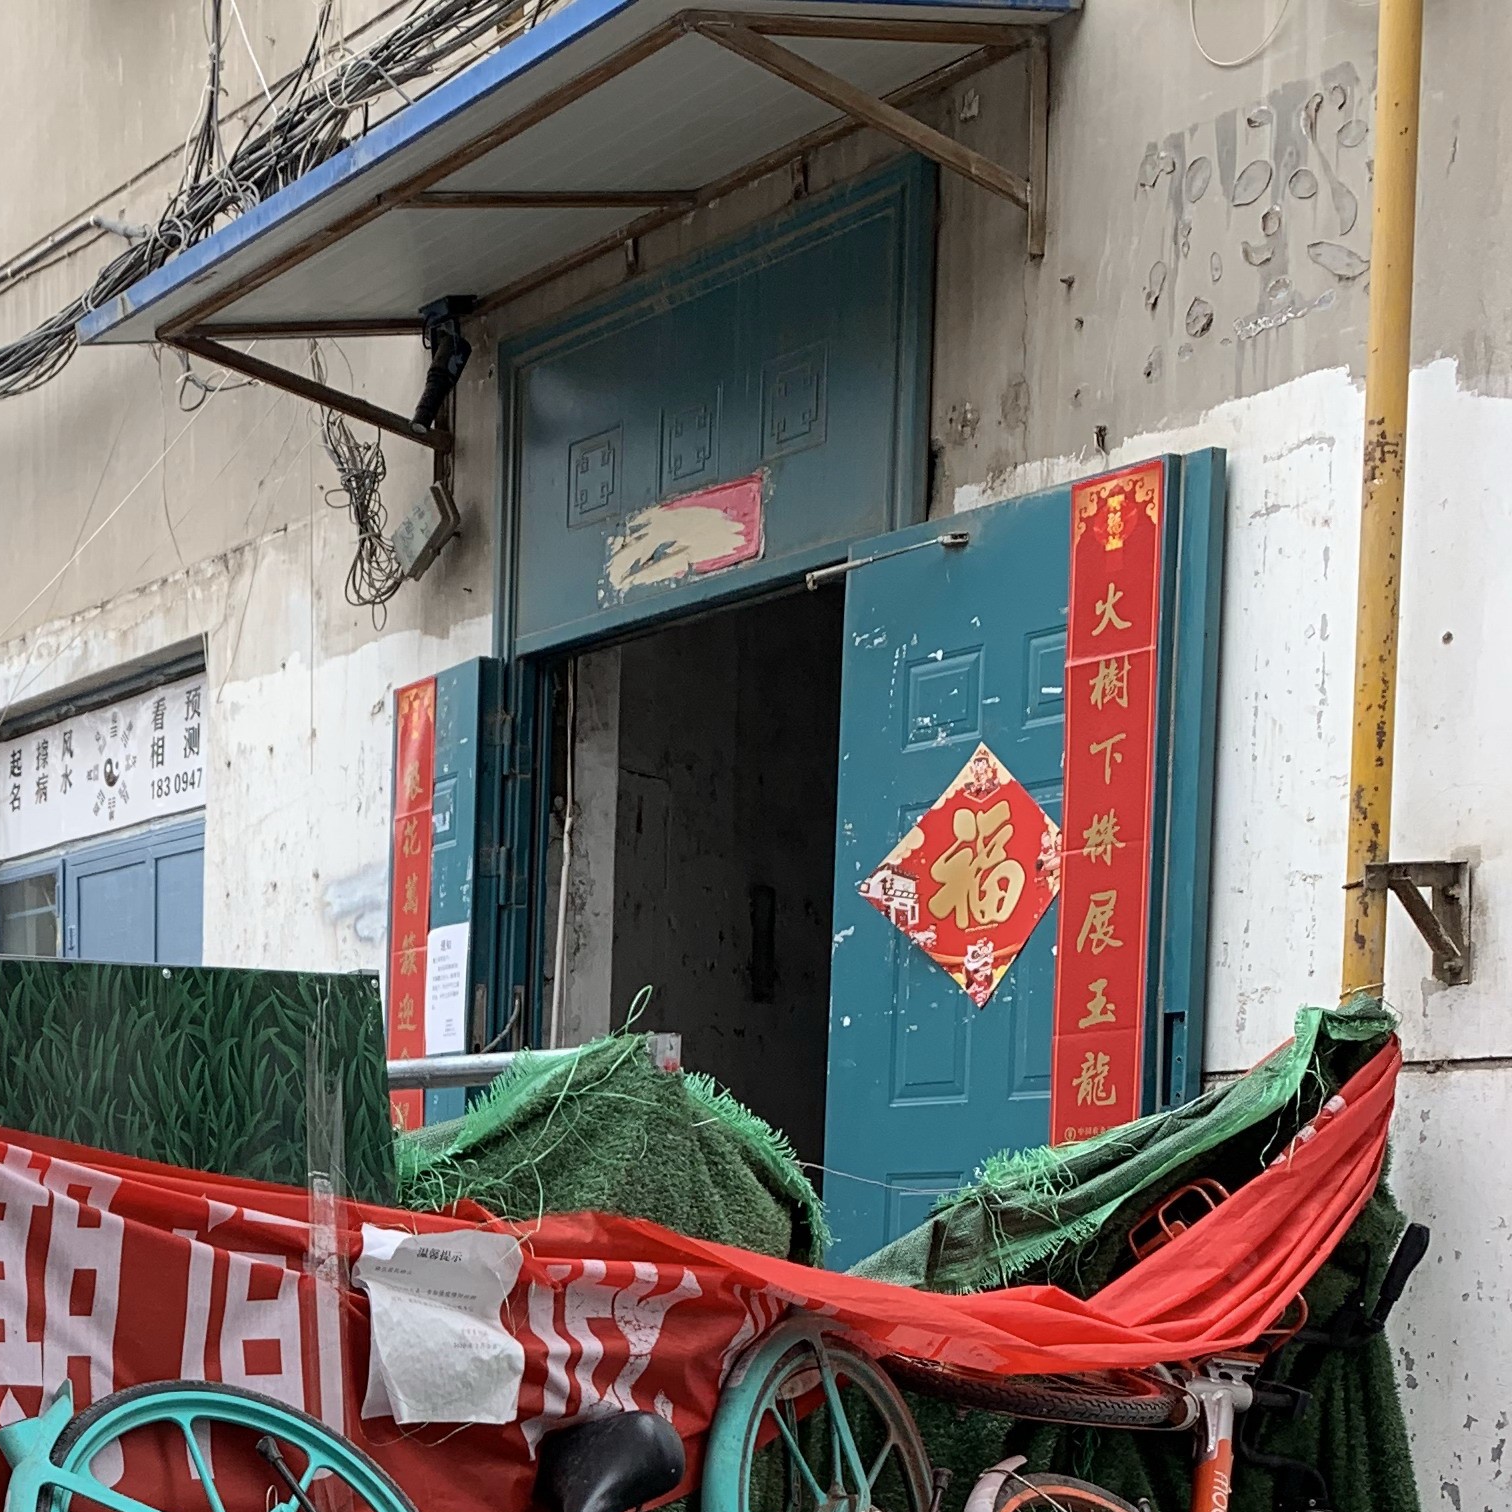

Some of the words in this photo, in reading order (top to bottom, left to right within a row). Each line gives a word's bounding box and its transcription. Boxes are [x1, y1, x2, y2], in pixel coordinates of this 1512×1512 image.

[150, 696, 166, 770] 看相
[183, 685, 202, 759] 预测
[9, 748, 23, 813] 起名
[59, 728, 74, 796] 风水
[150, 776, 171, 800] 183
[174, 767, 203, 798] 0947
[927, 800, 1027, 931] 福
[416, 1246, 464, 1264] 温馨提示
